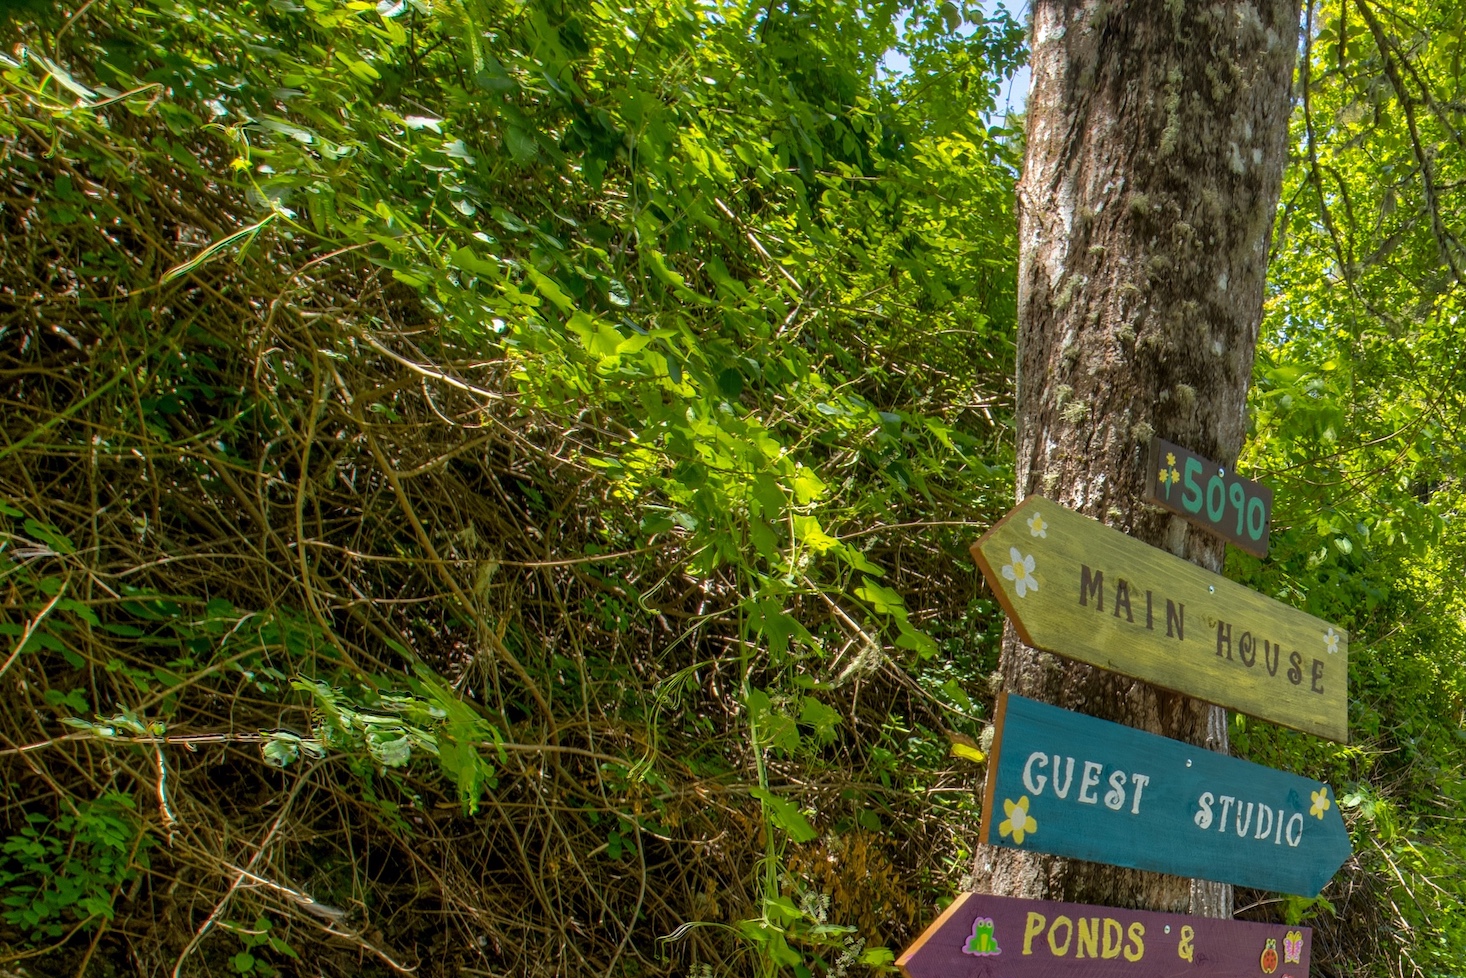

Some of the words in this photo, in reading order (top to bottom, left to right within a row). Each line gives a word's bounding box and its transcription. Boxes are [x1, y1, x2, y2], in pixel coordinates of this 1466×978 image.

[1181, 456, 1266, 541] 5090
[1079, 564, 1185, 641] MAIN
[1216, 619, 1325, 695] HOUSE
[1022, 752, 1149, 814] GUEST
[1194, 792, 1304, 847] STUDIO
[1021, 911, 1146, 962] PONDS
[1178, 924, 1195, 962] &
